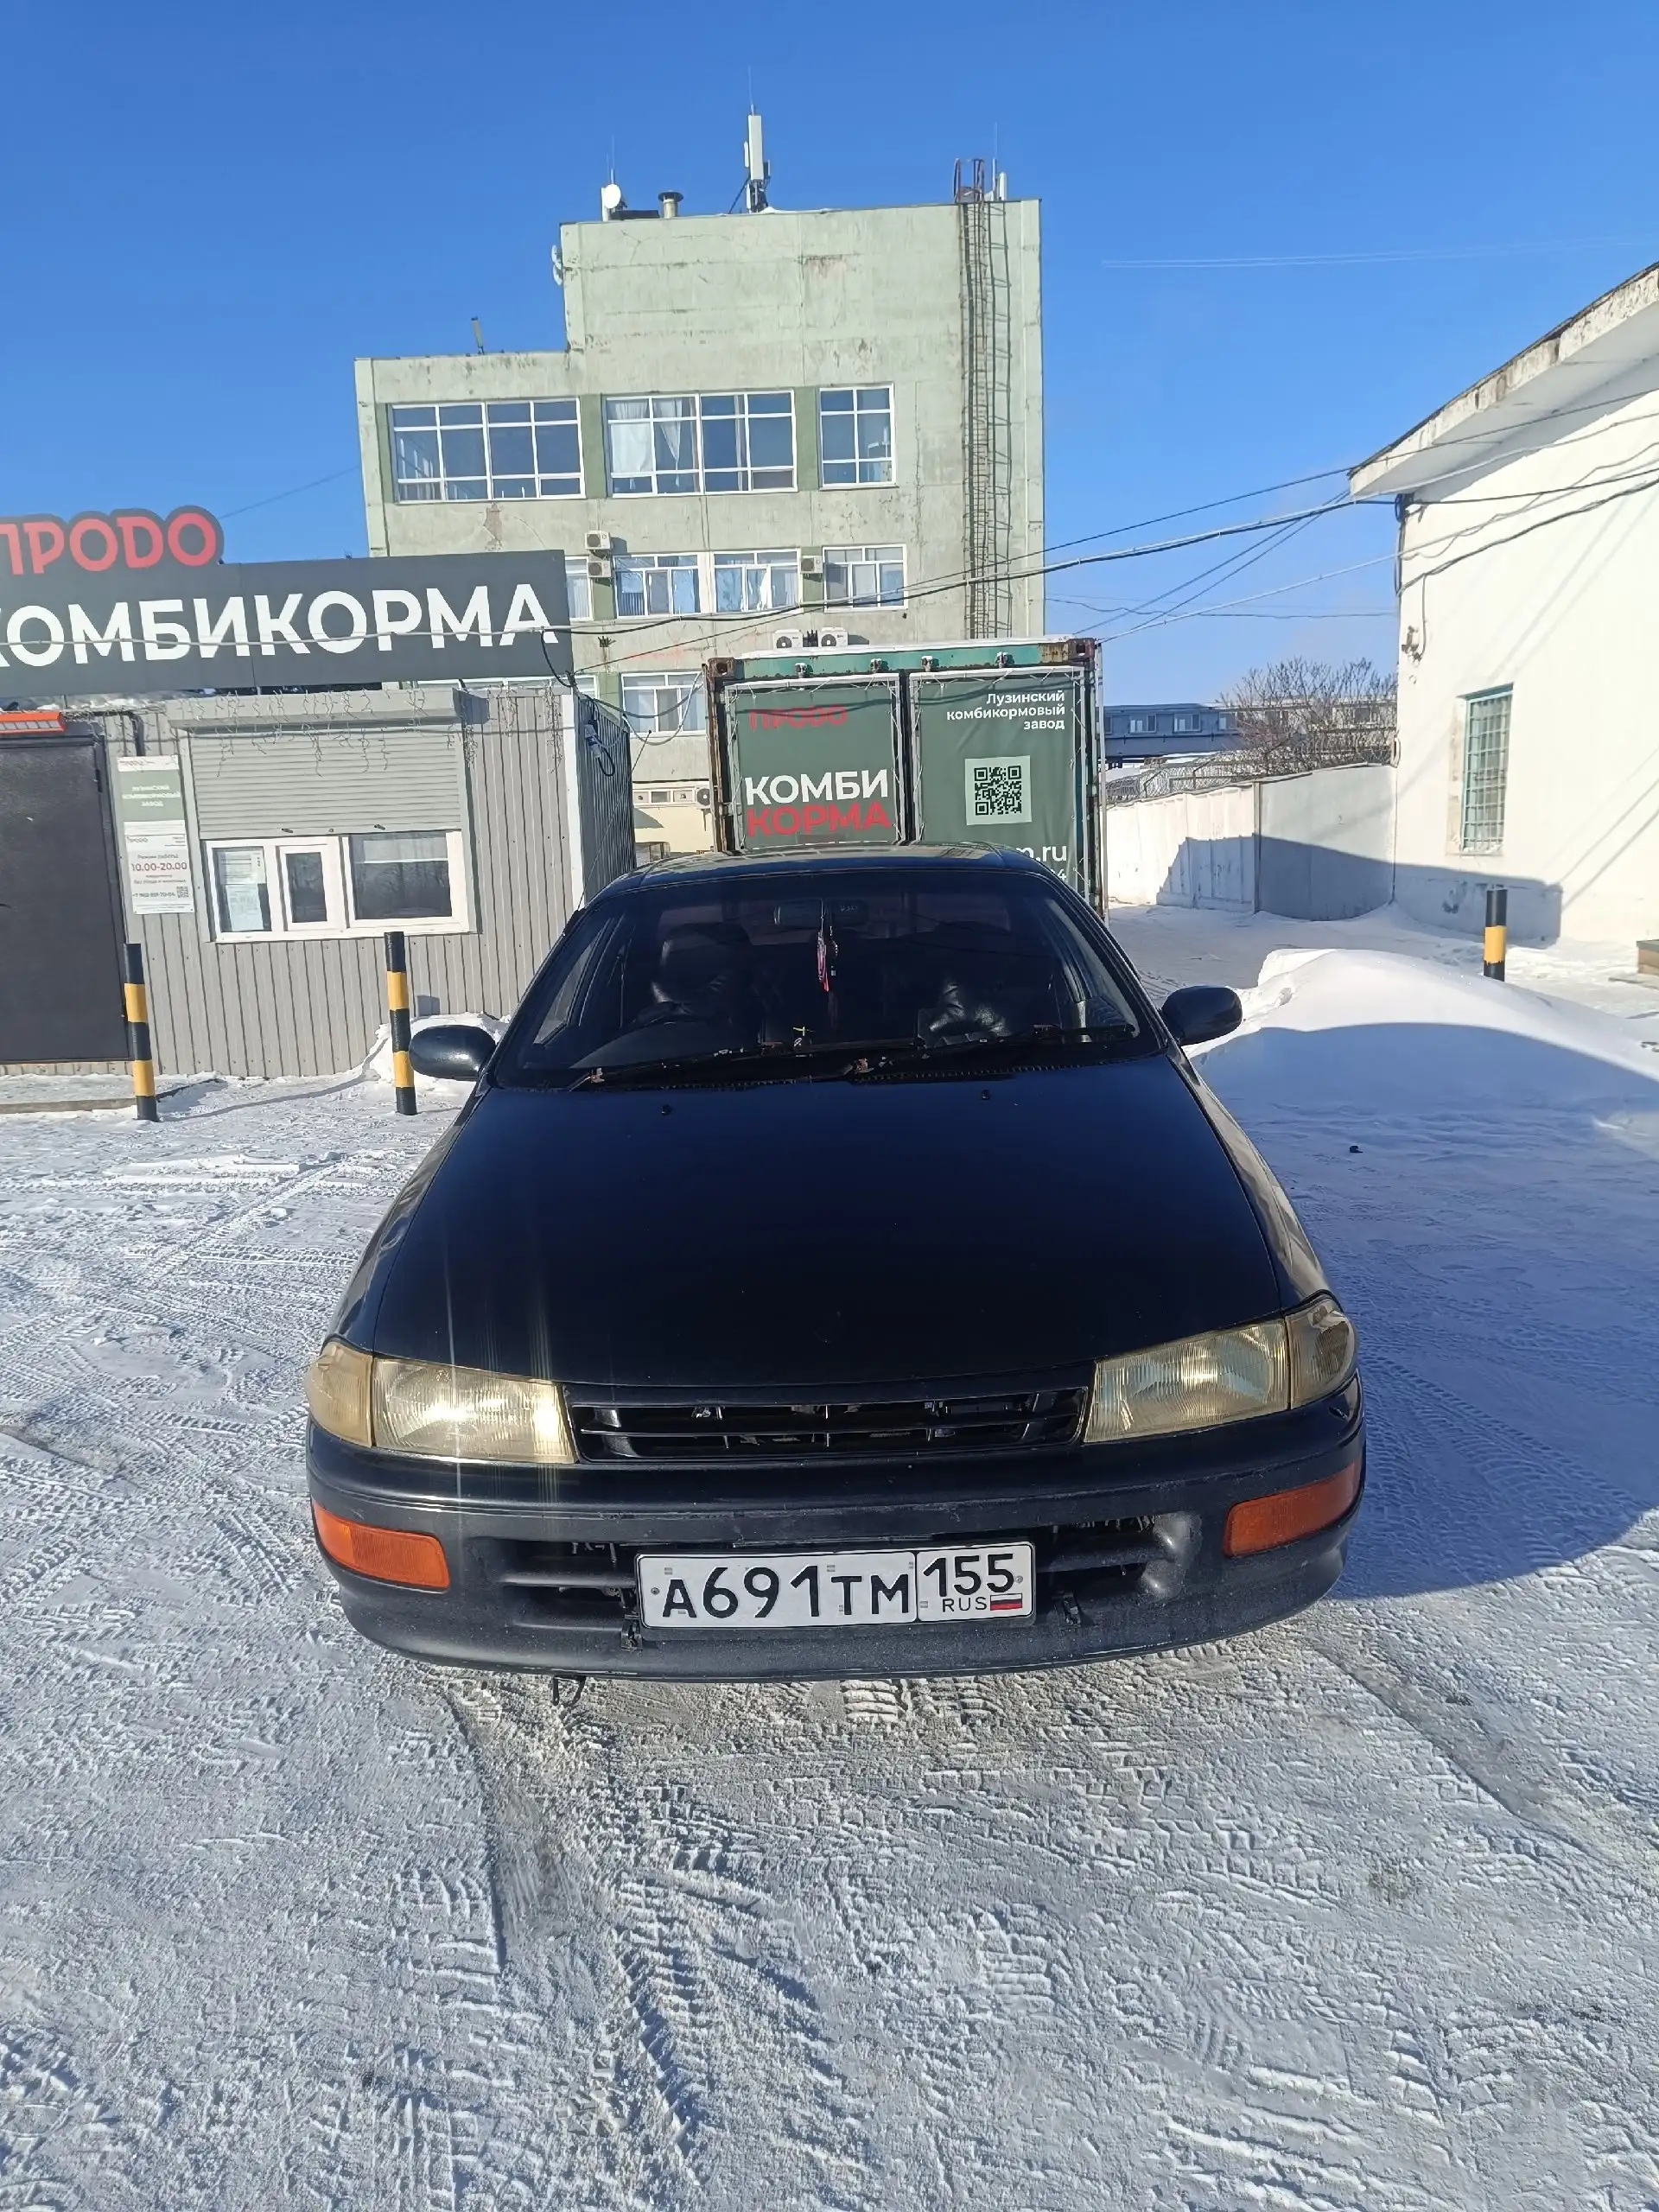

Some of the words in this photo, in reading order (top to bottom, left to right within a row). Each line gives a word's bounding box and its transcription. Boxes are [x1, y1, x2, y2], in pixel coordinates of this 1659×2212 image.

[0, 583, 559, 667] ОМБИКОРМА
[946, 703, 1065, 721] комбикормовый
[986, 690, 1065, 707] Лузинский
[1023, 720, 1065, 730] завод
[744, 769, 888, 805] КОМБИ
[747, 801, 892, 838] КОРМА
[923, 1553, 1014, 1597] 155
[942, 1596, 988, 1612] RUS
